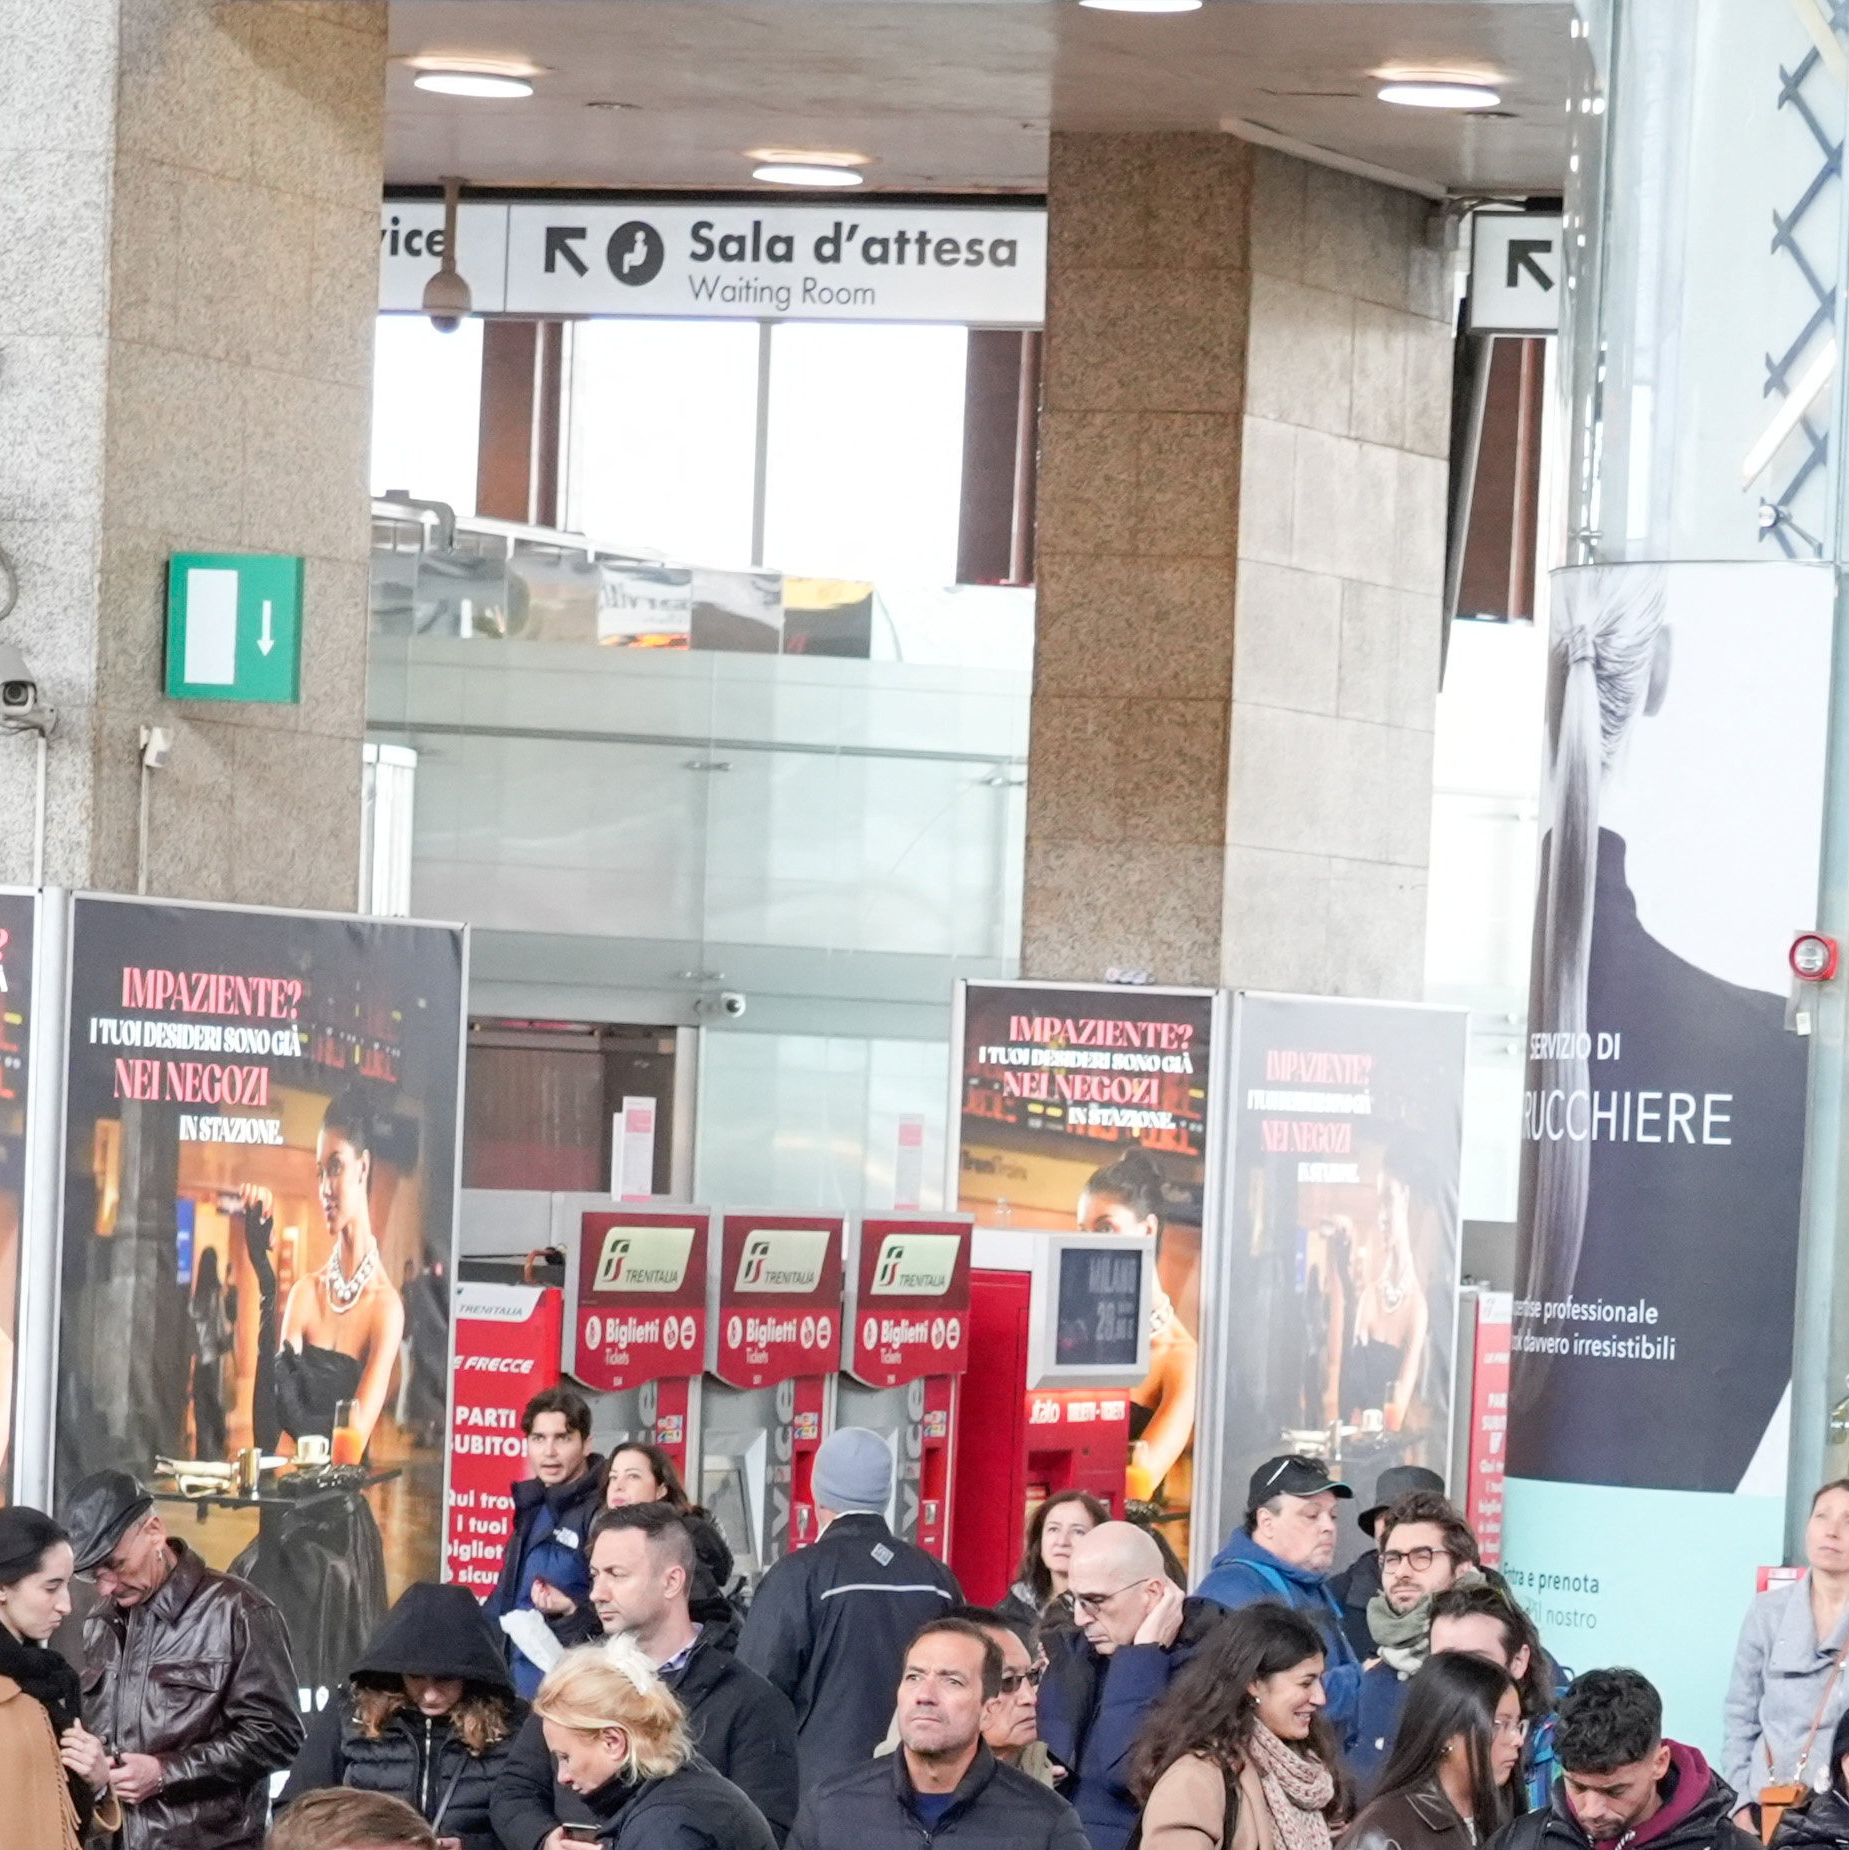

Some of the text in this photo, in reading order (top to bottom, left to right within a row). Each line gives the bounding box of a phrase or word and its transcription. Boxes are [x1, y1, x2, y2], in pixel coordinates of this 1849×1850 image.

[380, 216, 446, 258] ice
[689, 221, 795, 264] Sala
[689, 274, 876, 311] Waiting Room
[121, 967, 305, 1019] IMPAZIENTE?
[90, 1017, 97, 1043] I
[99, 1018, 142, 1046] TUOI
[143, 1022, 222, 1052] DESIDERI
[224, 1027, 270, 1055] SONO
[1009, 1015, 1194, 1050] IMPAZIENTE?
[1530, 1031, 1621, 1060] SERVIZIO DI
[113, 1058, 270, 1106] NEI NEGOZI
[1002, 1071, 1159, 1105] NEI NEGOZI
[179, 1115, 198, 1141] IN
[625, 1269, 679, 1284] TRENITALIA
[764, 1271, 816, 1285] TRENITALIA
[899, 1273, 946, 1288] TRENITALIA
[458, 1303, 524, 1317] TRENITALIA
[1544, 1295, 1658, 1324] professionale
[605, 1317, 659, 1347] Biglietti
[746, 1318, 797, 1348] Biglietti
[880, 1319, 928, 1348] Biglietti
[1573, 1332, 1676, 1360] irresistibili
[464, 1356, 536, 1375] FRECCE
[455, 1406, 517, 1429] PARTI
[469, 1515, 508, 1535] tuoi
[1538, 1574, 1599, 1595] prenota
[1546, 1607, 1597, 1630] nostro
